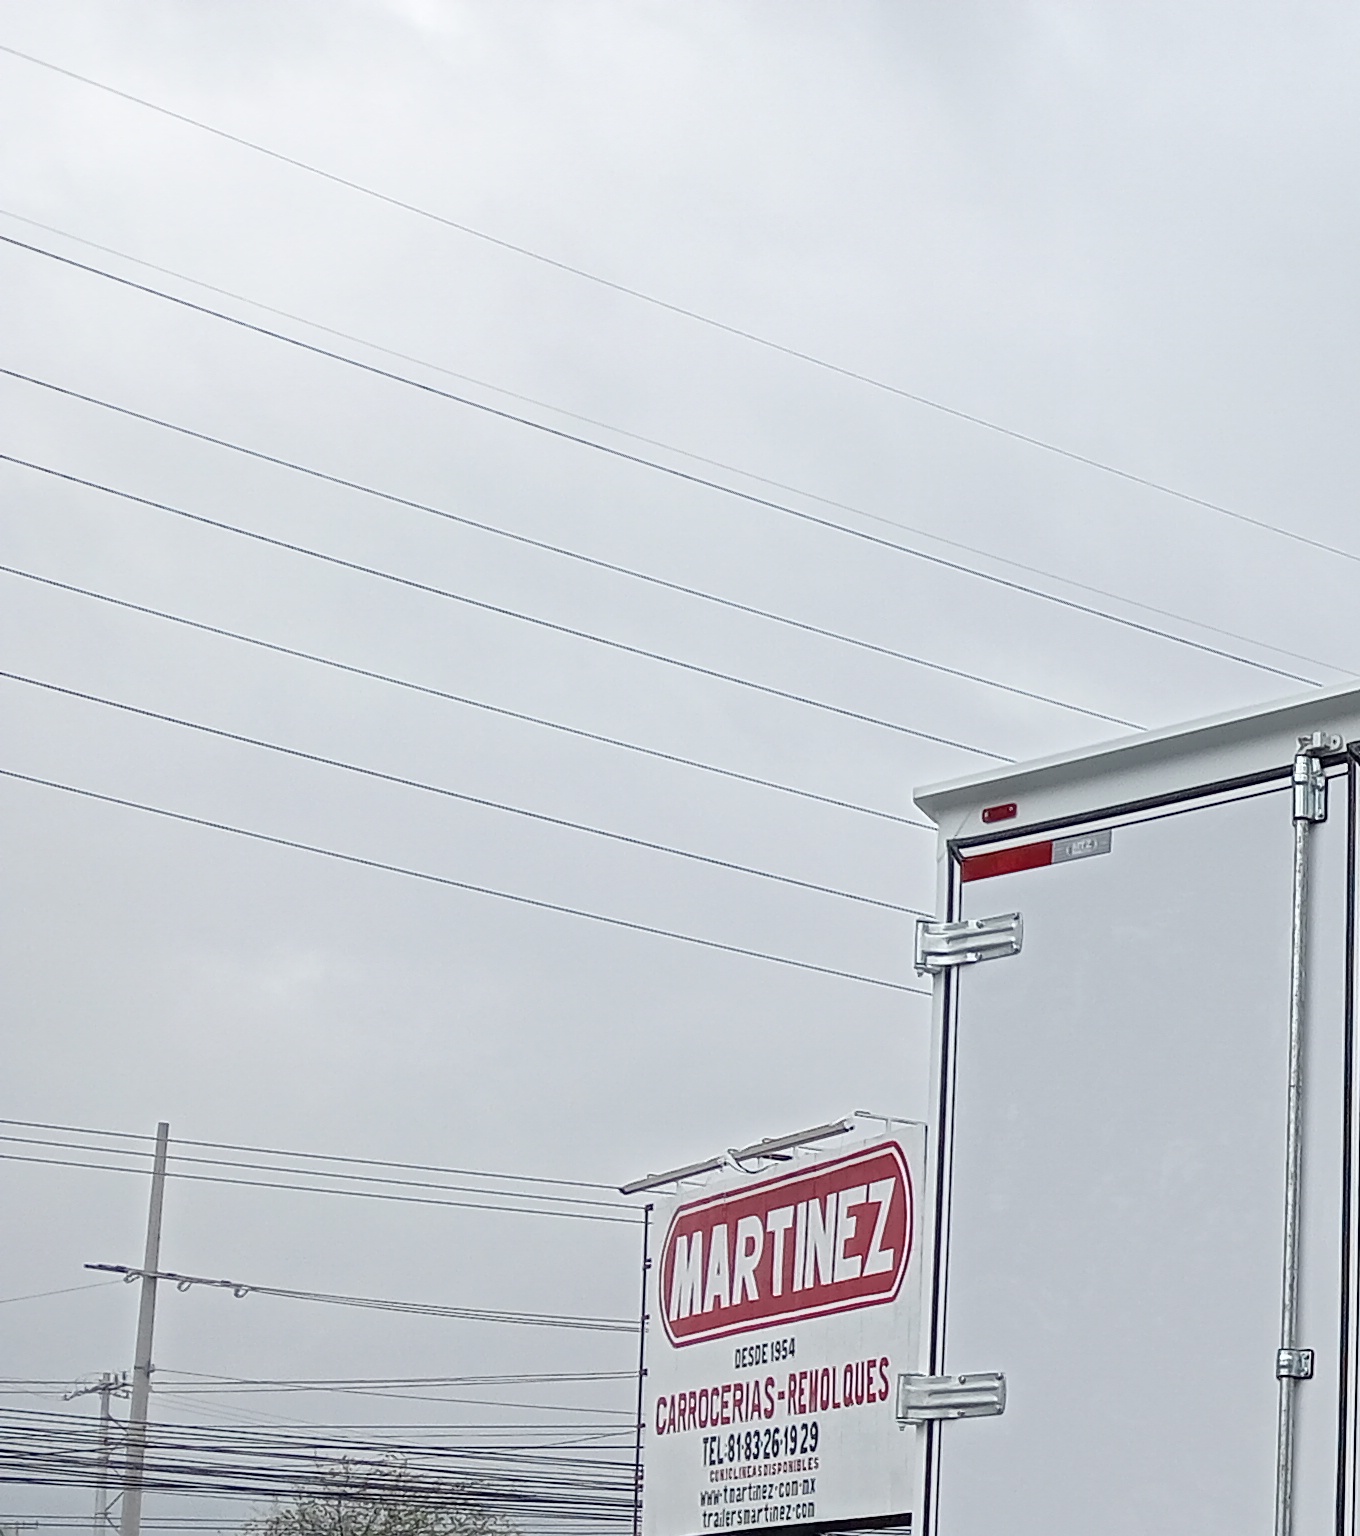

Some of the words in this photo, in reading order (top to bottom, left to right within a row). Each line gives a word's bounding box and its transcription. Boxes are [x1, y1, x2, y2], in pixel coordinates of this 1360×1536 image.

[669, 1177, 897, 1322] MARTINEZ
[734, 1342, 768, 1369] DESDE
[770, 1337, 796, 1363] 1954
